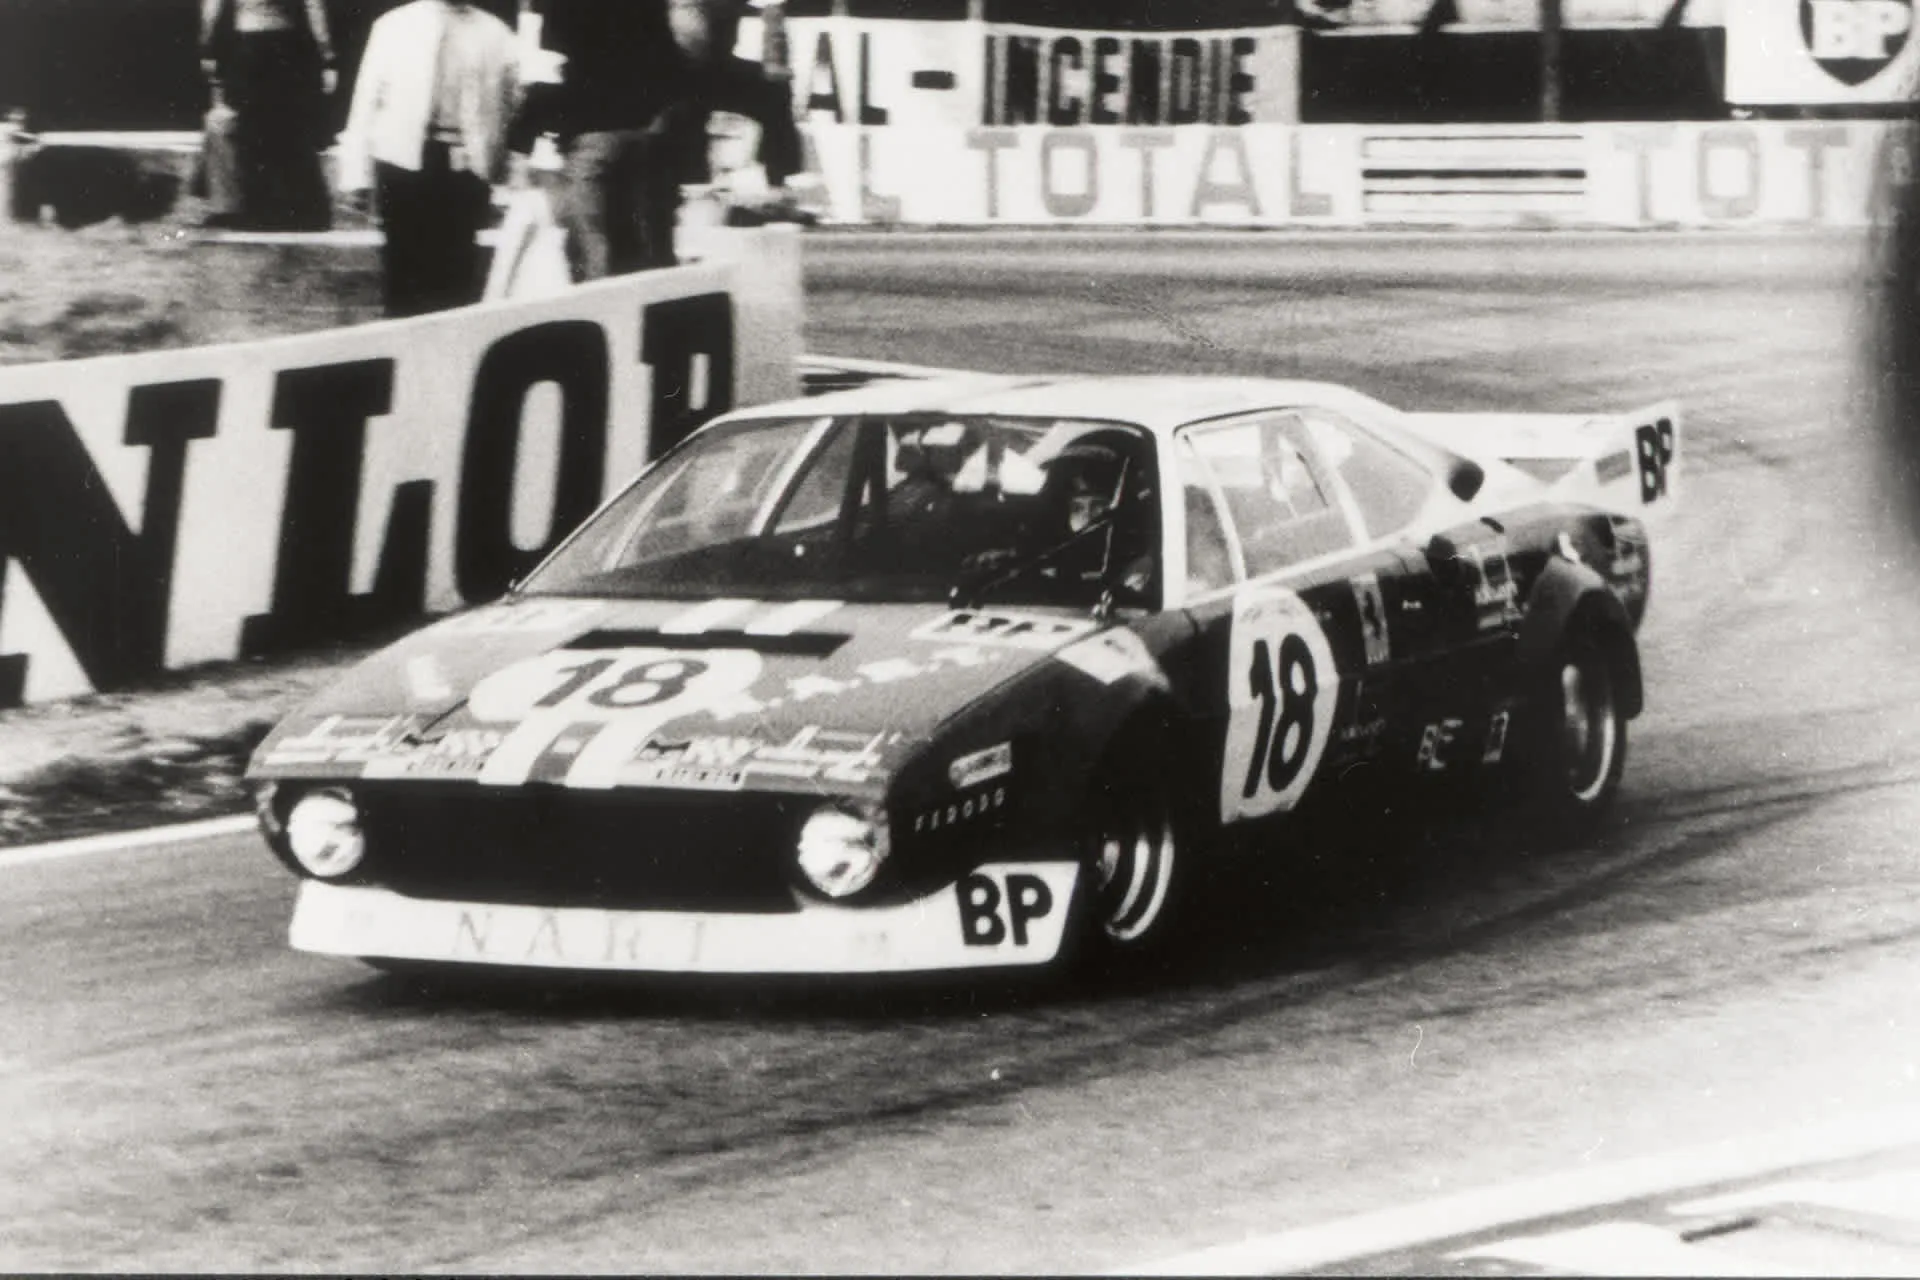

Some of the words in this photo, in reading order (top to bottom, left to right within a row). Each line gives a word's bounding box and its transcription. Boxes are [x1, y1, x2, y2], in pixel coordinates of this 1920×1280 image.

[1812, 0, 1911, 58] BP
[981, 35, 1255, 125] INCENDIE
[966, 131, 1332, 218] TOTAL
[1636, 417, 1673, 504] BP
[533, 657, 709, 708] 18
[1242, 632, 1318, 799] 18
[956, 873, 1053, 947] BP
